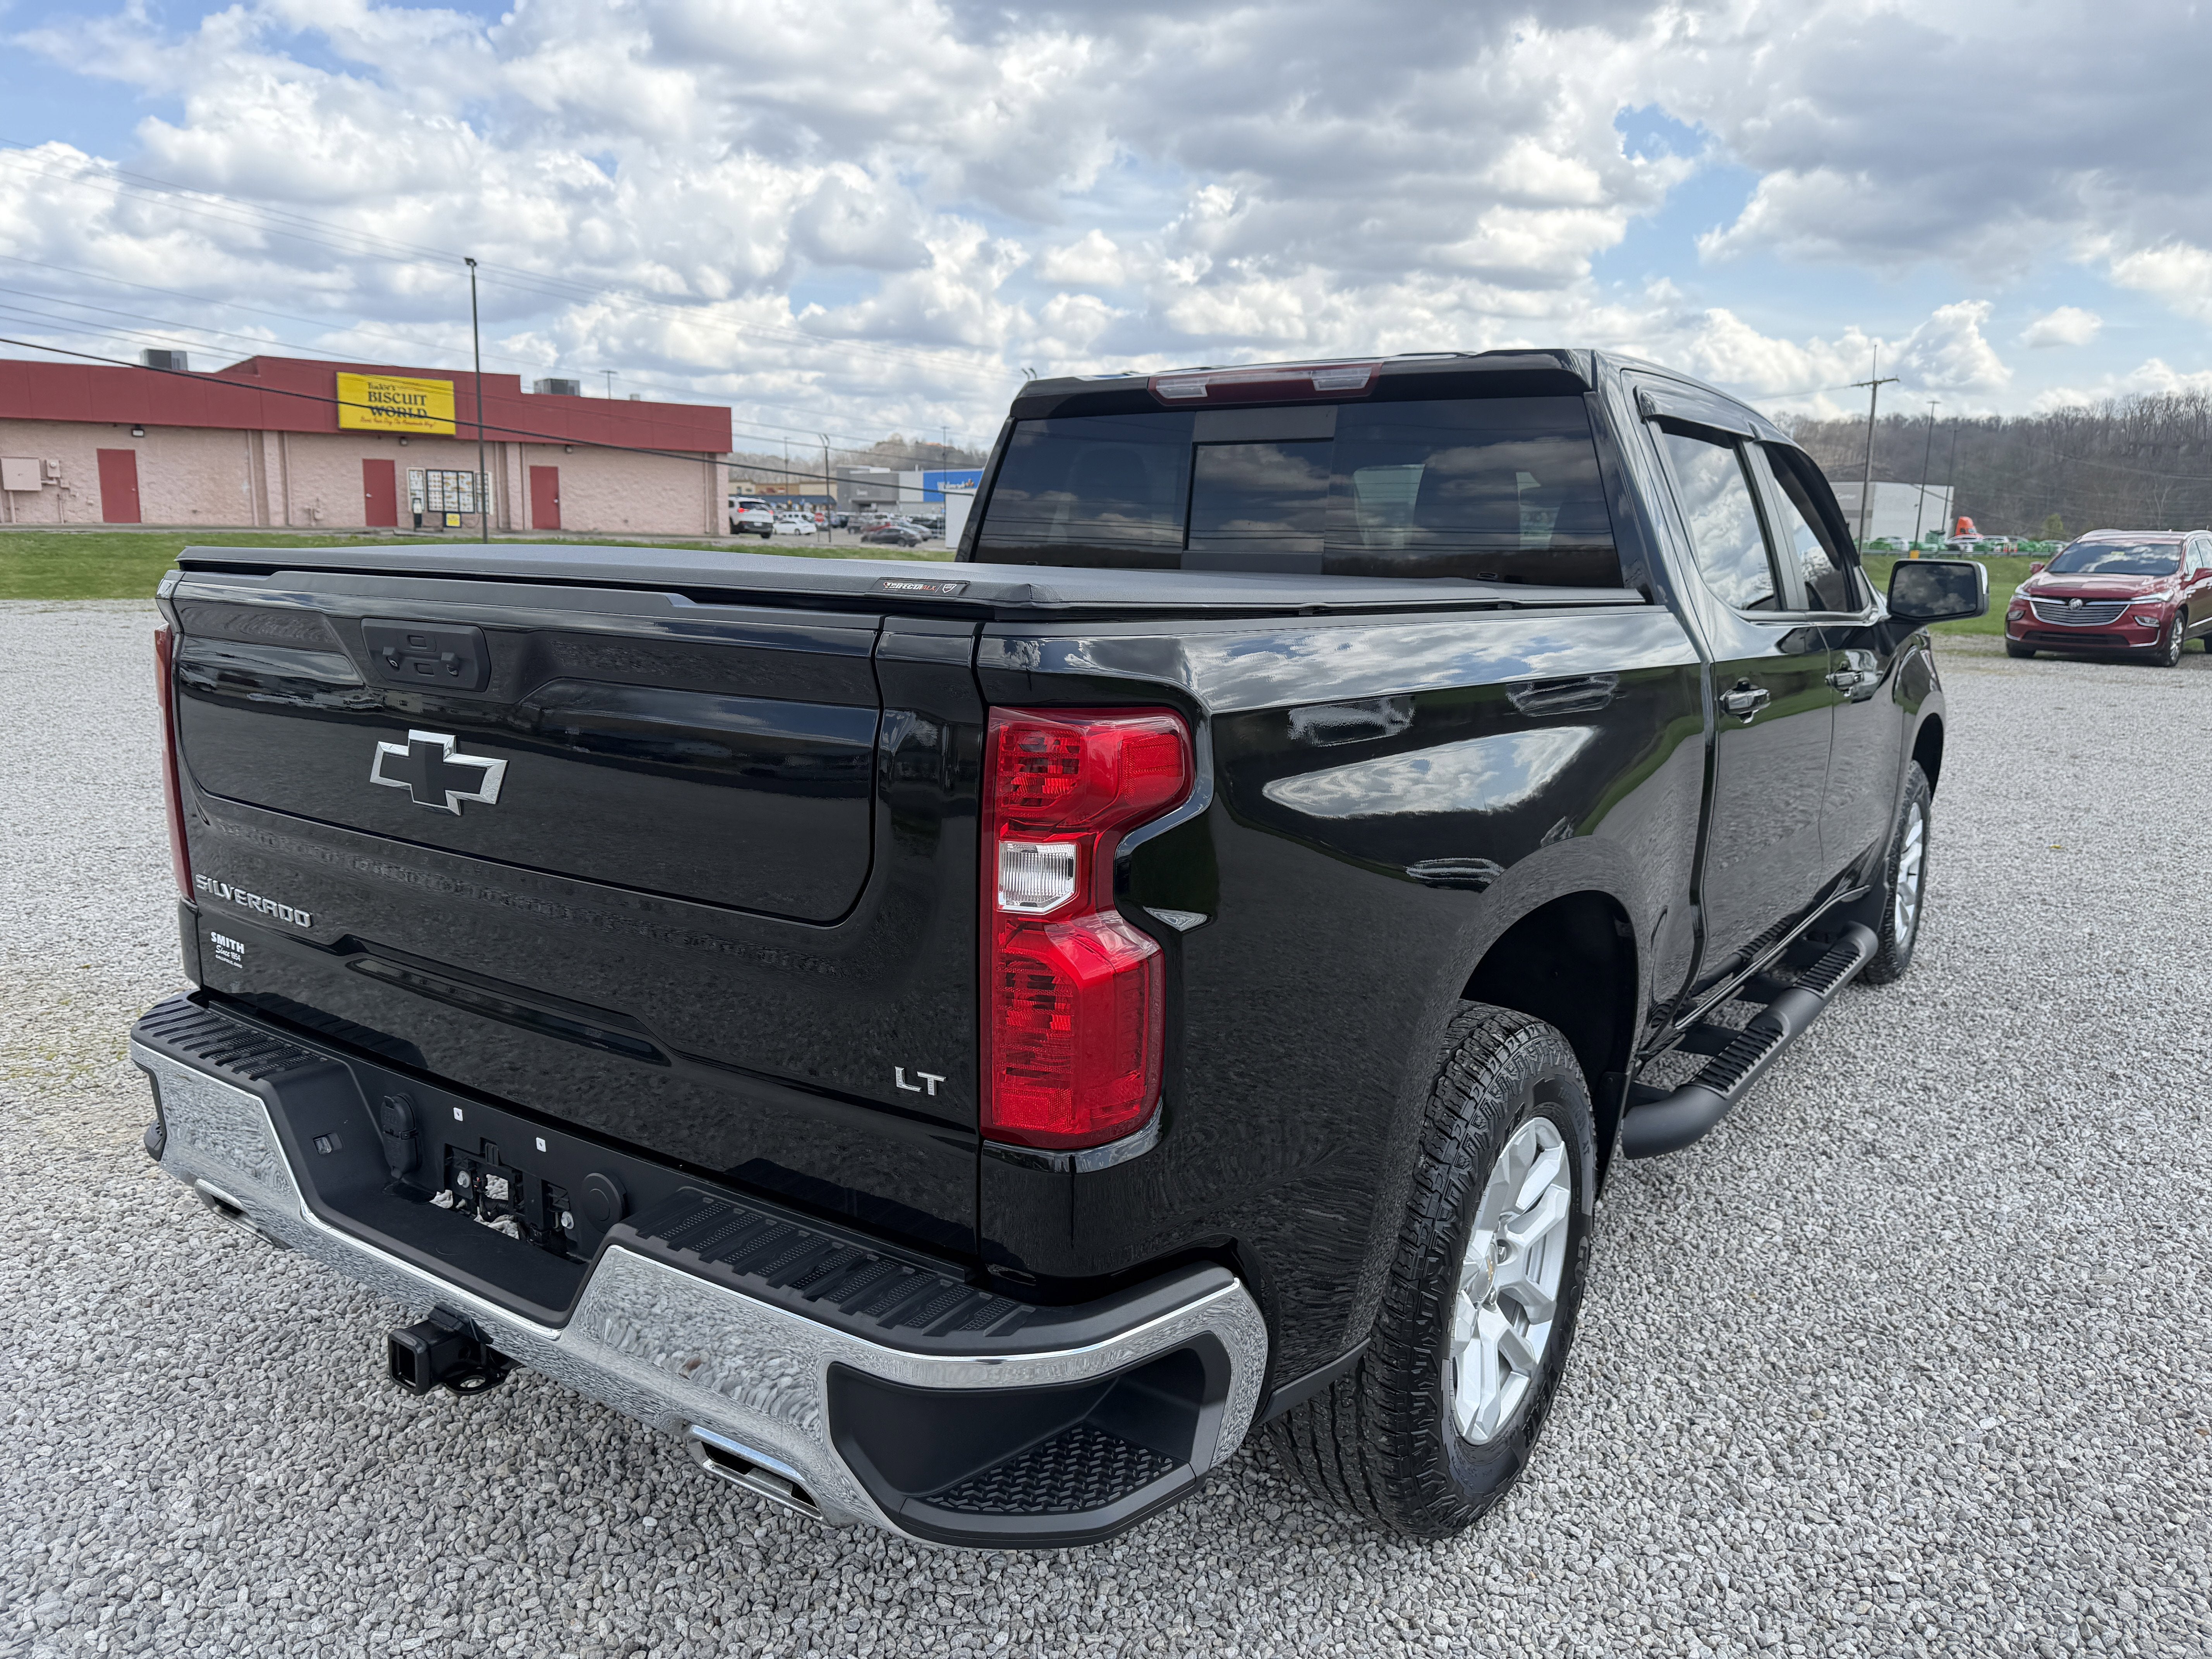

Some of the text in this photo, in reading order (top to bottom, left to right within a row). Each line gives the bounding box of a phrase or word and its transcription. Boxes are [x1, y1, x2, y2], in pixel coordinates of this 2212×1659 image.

[368, 392, 427, 406] BISCUIT
[369, 405, 428, 418] WORLD
[196, 873, 311, 927] SILVERADO
[211, 931, 245, 954] SMITH
[215, 945, 230, 957] Since
[895, 1066, 947, 1096] LT
